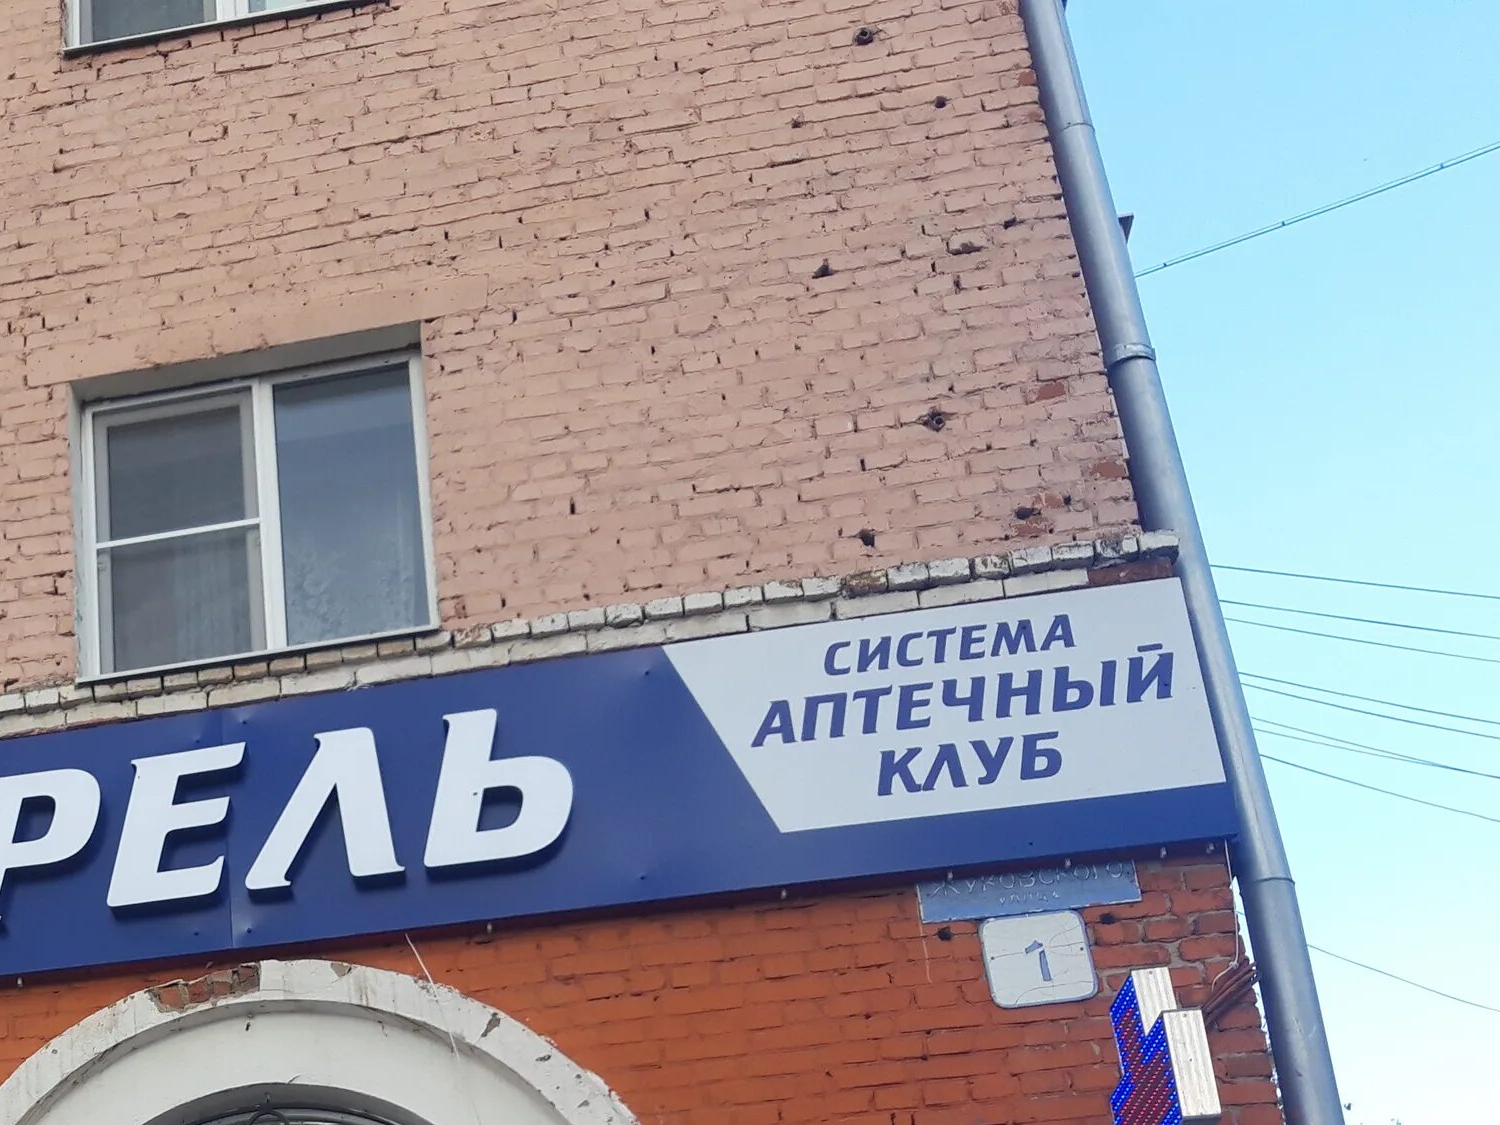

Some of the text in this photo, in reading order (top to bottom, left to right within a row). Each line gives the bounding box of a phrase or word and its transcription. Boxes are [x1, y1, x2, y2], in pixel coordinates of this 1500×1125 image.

[824, 613, 1076, 676] СИСТЕМА
[751, 643, 1175, 747] АПТЕЧНЫЙ
[877, 731, 1062, 796] КЛУБ
[1025, 940, 1052, 981] 1
